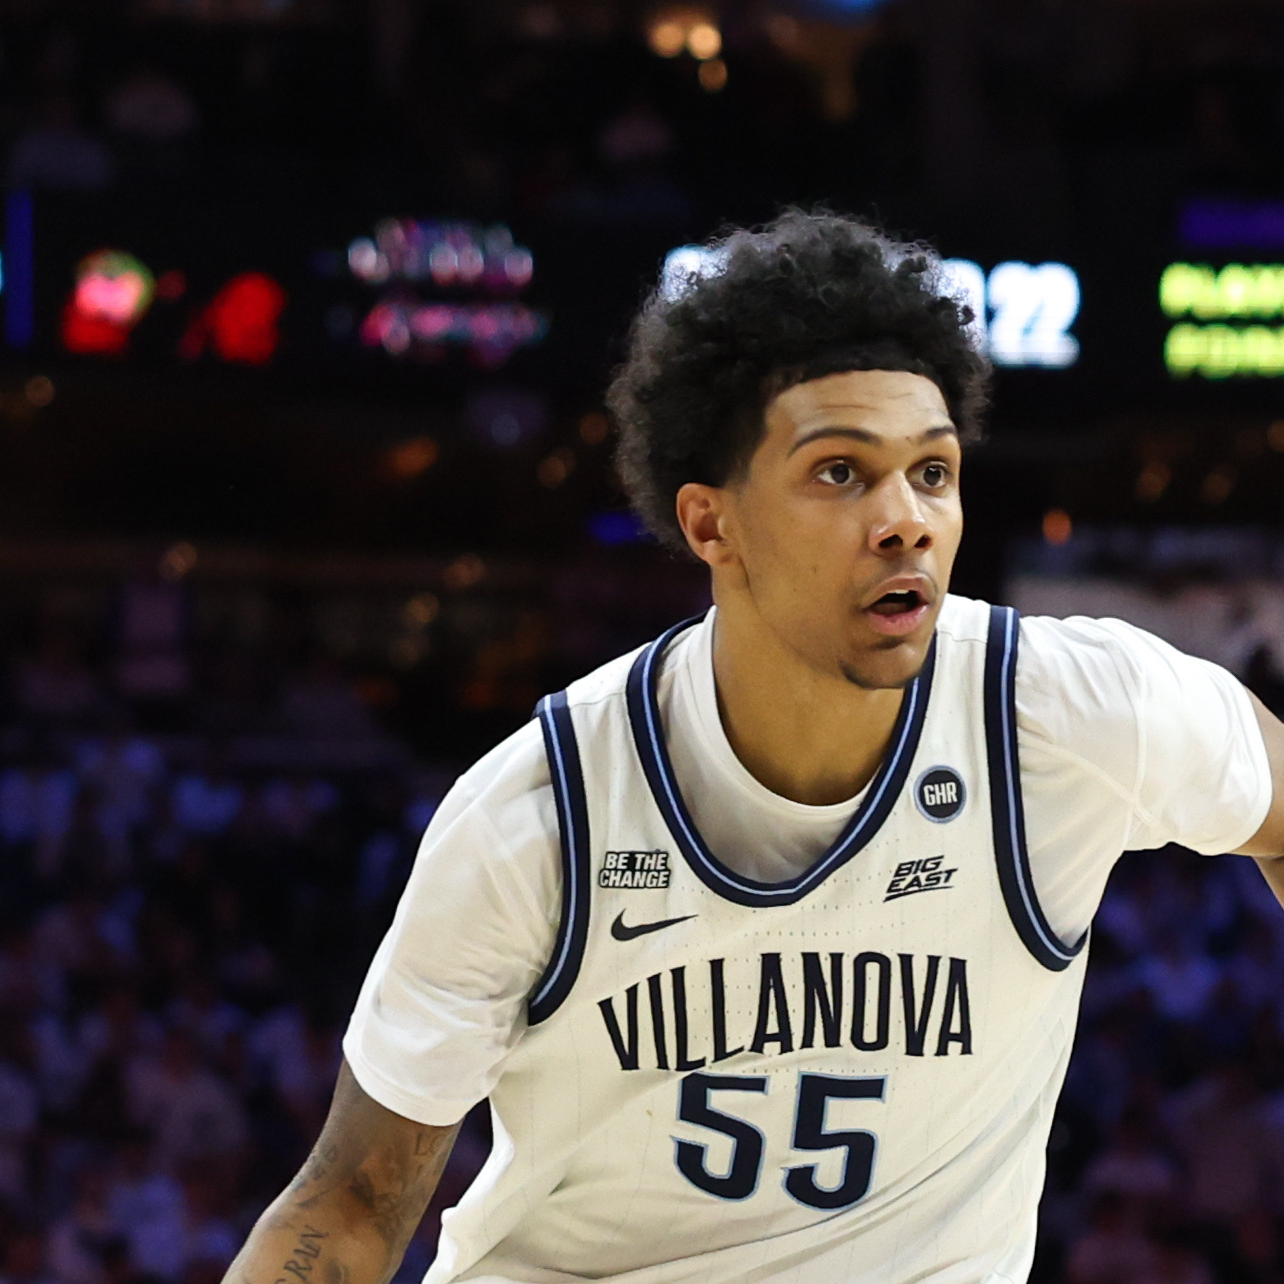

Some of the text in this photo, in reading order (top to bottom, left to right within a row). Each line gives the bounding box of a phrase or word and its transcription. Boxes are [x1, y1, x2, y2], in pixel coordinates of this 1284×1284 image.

[923, 782, 958, 806] GHR
[605, 853, 668, 871] BE THE
[893, 854, 945, 879] BIG
[599, 870, 670, 888] CHANGE
[885, 867, 959, 894] EAST
[597, 952, 973, 1072] VILLANOVA
[670, 1071, 890, 1213] 55
